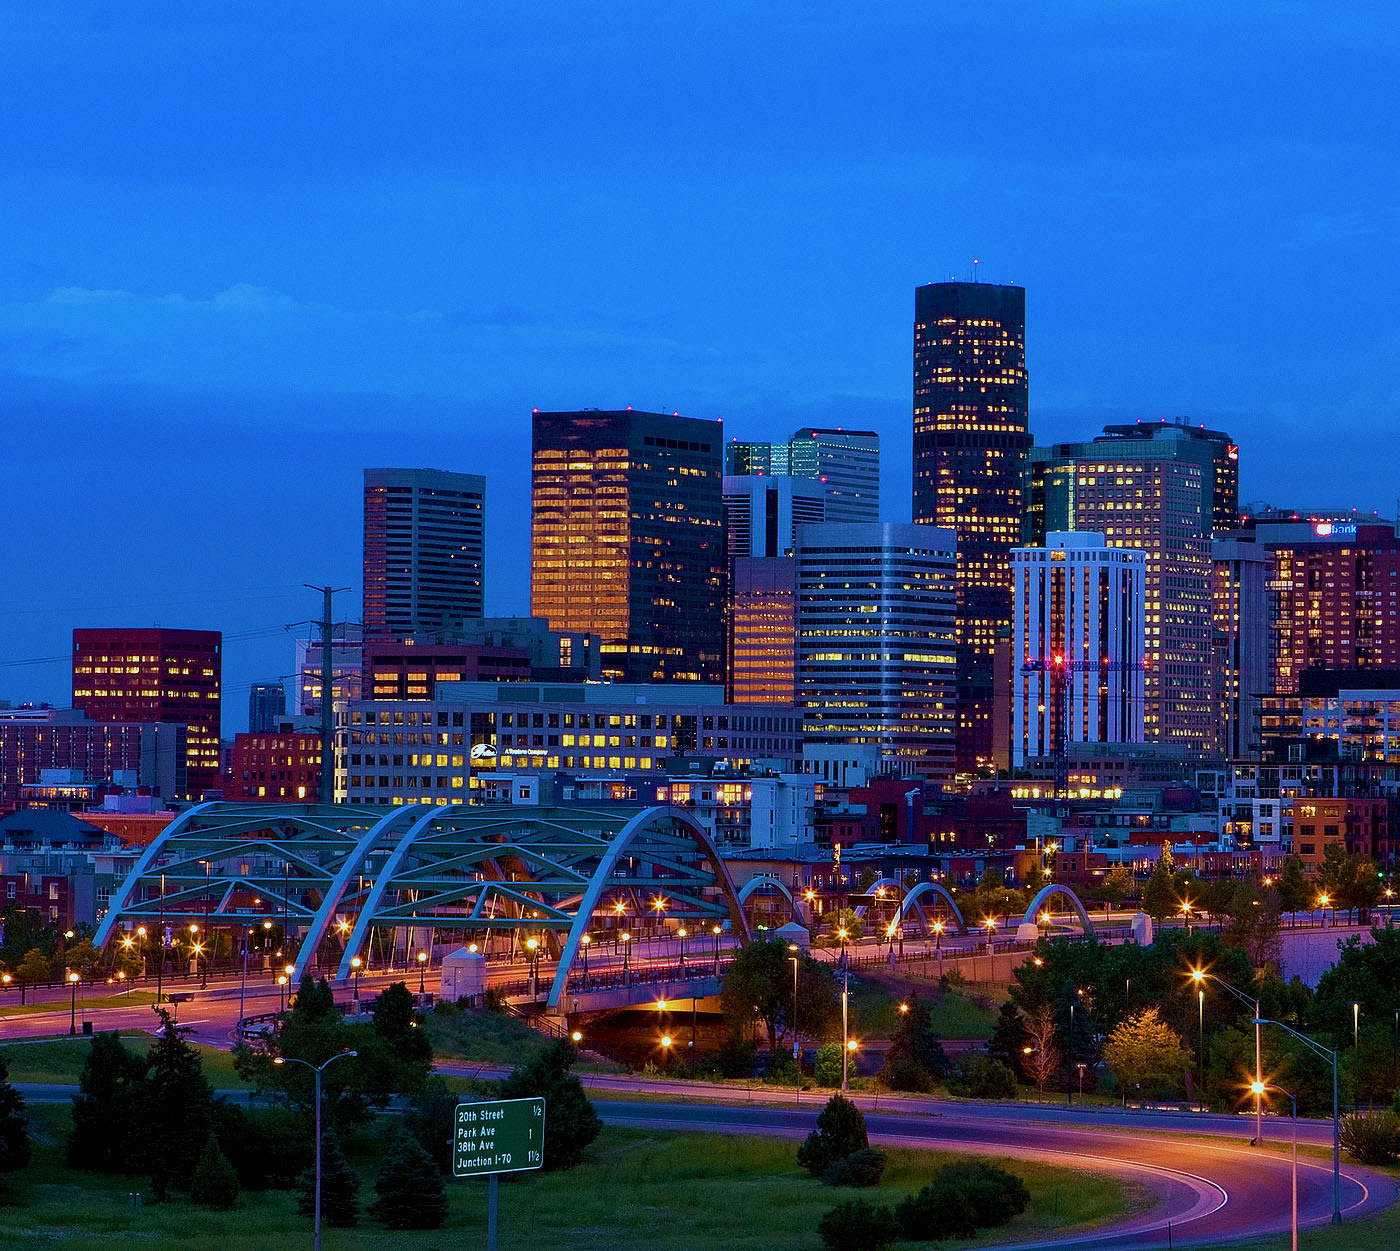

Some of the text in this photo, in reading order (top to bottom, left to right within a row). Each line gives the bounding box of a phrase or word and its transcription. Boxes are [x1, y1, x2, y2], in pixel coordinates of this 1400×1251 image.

[1331, 524, 1357, 534] bank
[459, 1111, 477, 1122] 20th
[480, 1109, 504, 1120] Street
[458, 1126, 496, 1138] Park Ave
[528, 1128, 533, 1139] 1
[458, 1140, 494, 1152] 38th Ave
[457, 1156, 492, 1168] Junction
[495, 1153, 512, 1165] I-70
